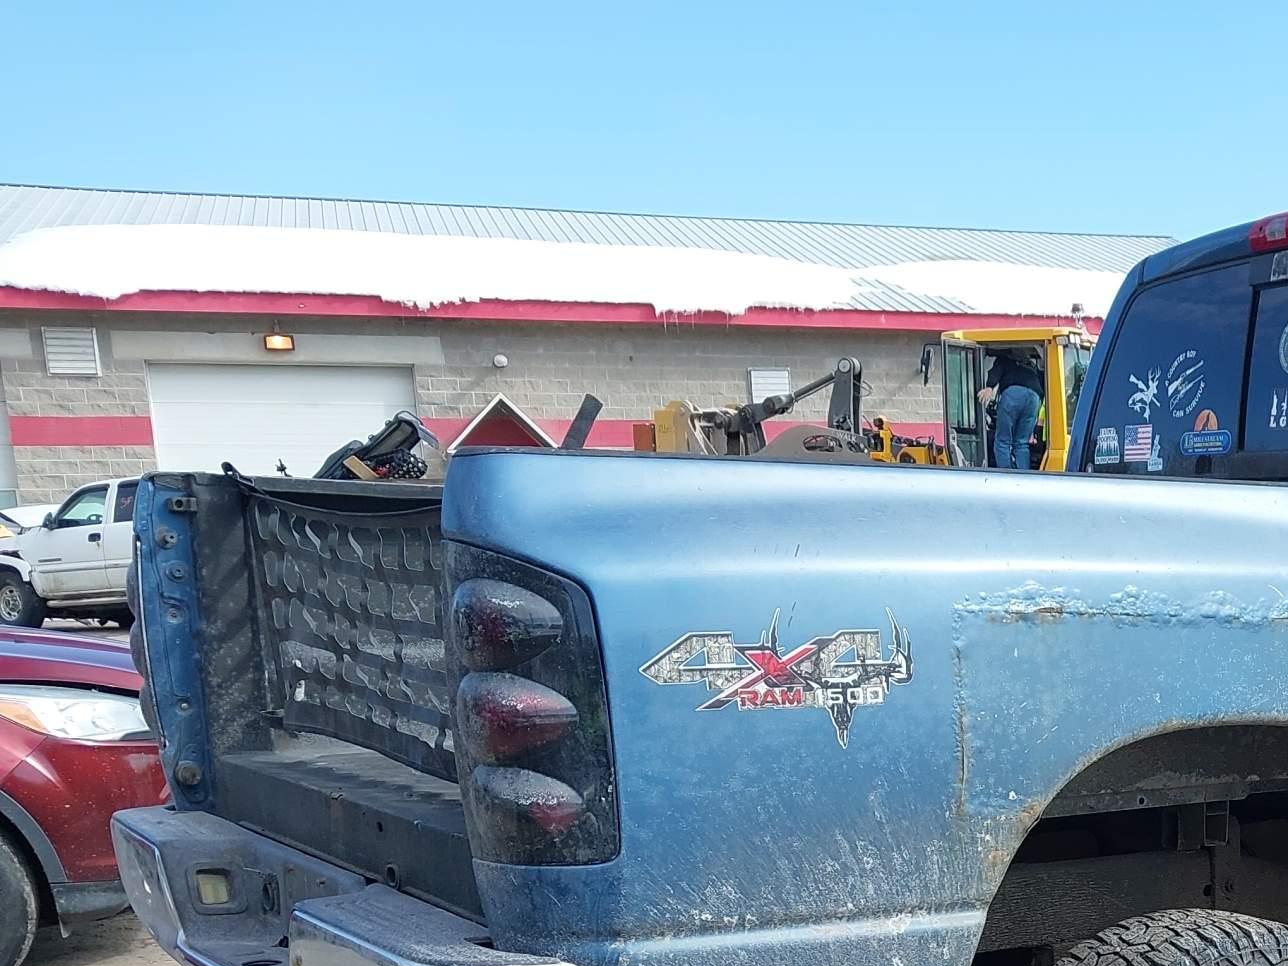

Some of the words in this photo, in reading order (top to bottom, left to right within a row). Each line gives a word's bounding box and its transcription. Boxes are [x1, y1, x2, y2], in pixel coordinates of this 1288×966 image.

[1172, 409, 1184, 418] CAN
[1185, 380, 1205, 415] SURVIVE
[738, 686, 802, 707] RAM
[817, 685, 884, 706] 1500
